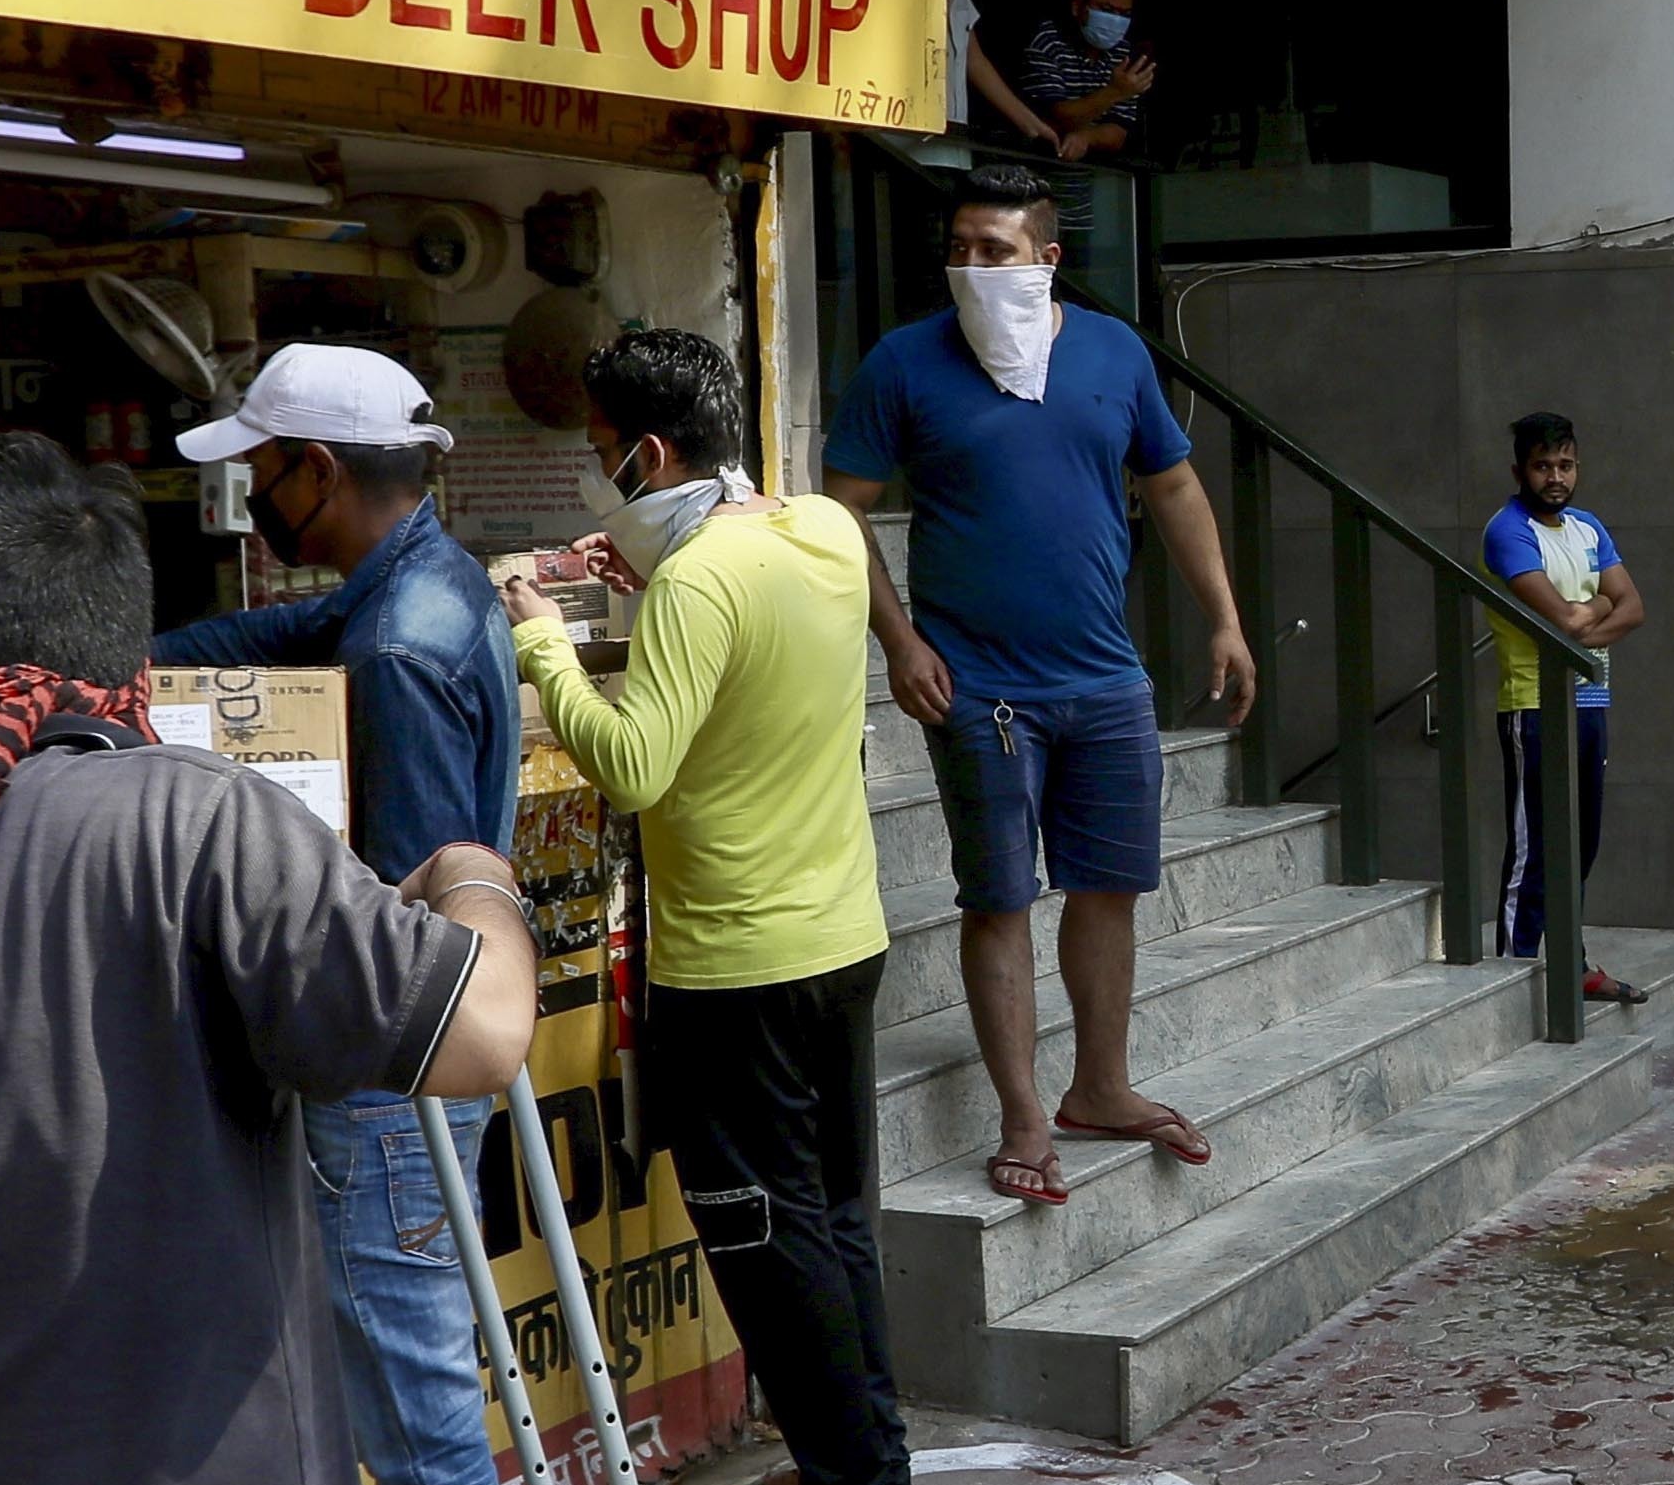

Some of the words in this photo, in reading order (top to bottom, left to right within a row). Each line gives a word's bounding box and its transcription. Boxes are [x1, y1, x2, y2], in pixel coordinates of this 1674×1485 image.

[834, 87, 851, 118] 12
[857, 80, 882, 120] से
[885, 96, 906, 125] 10
